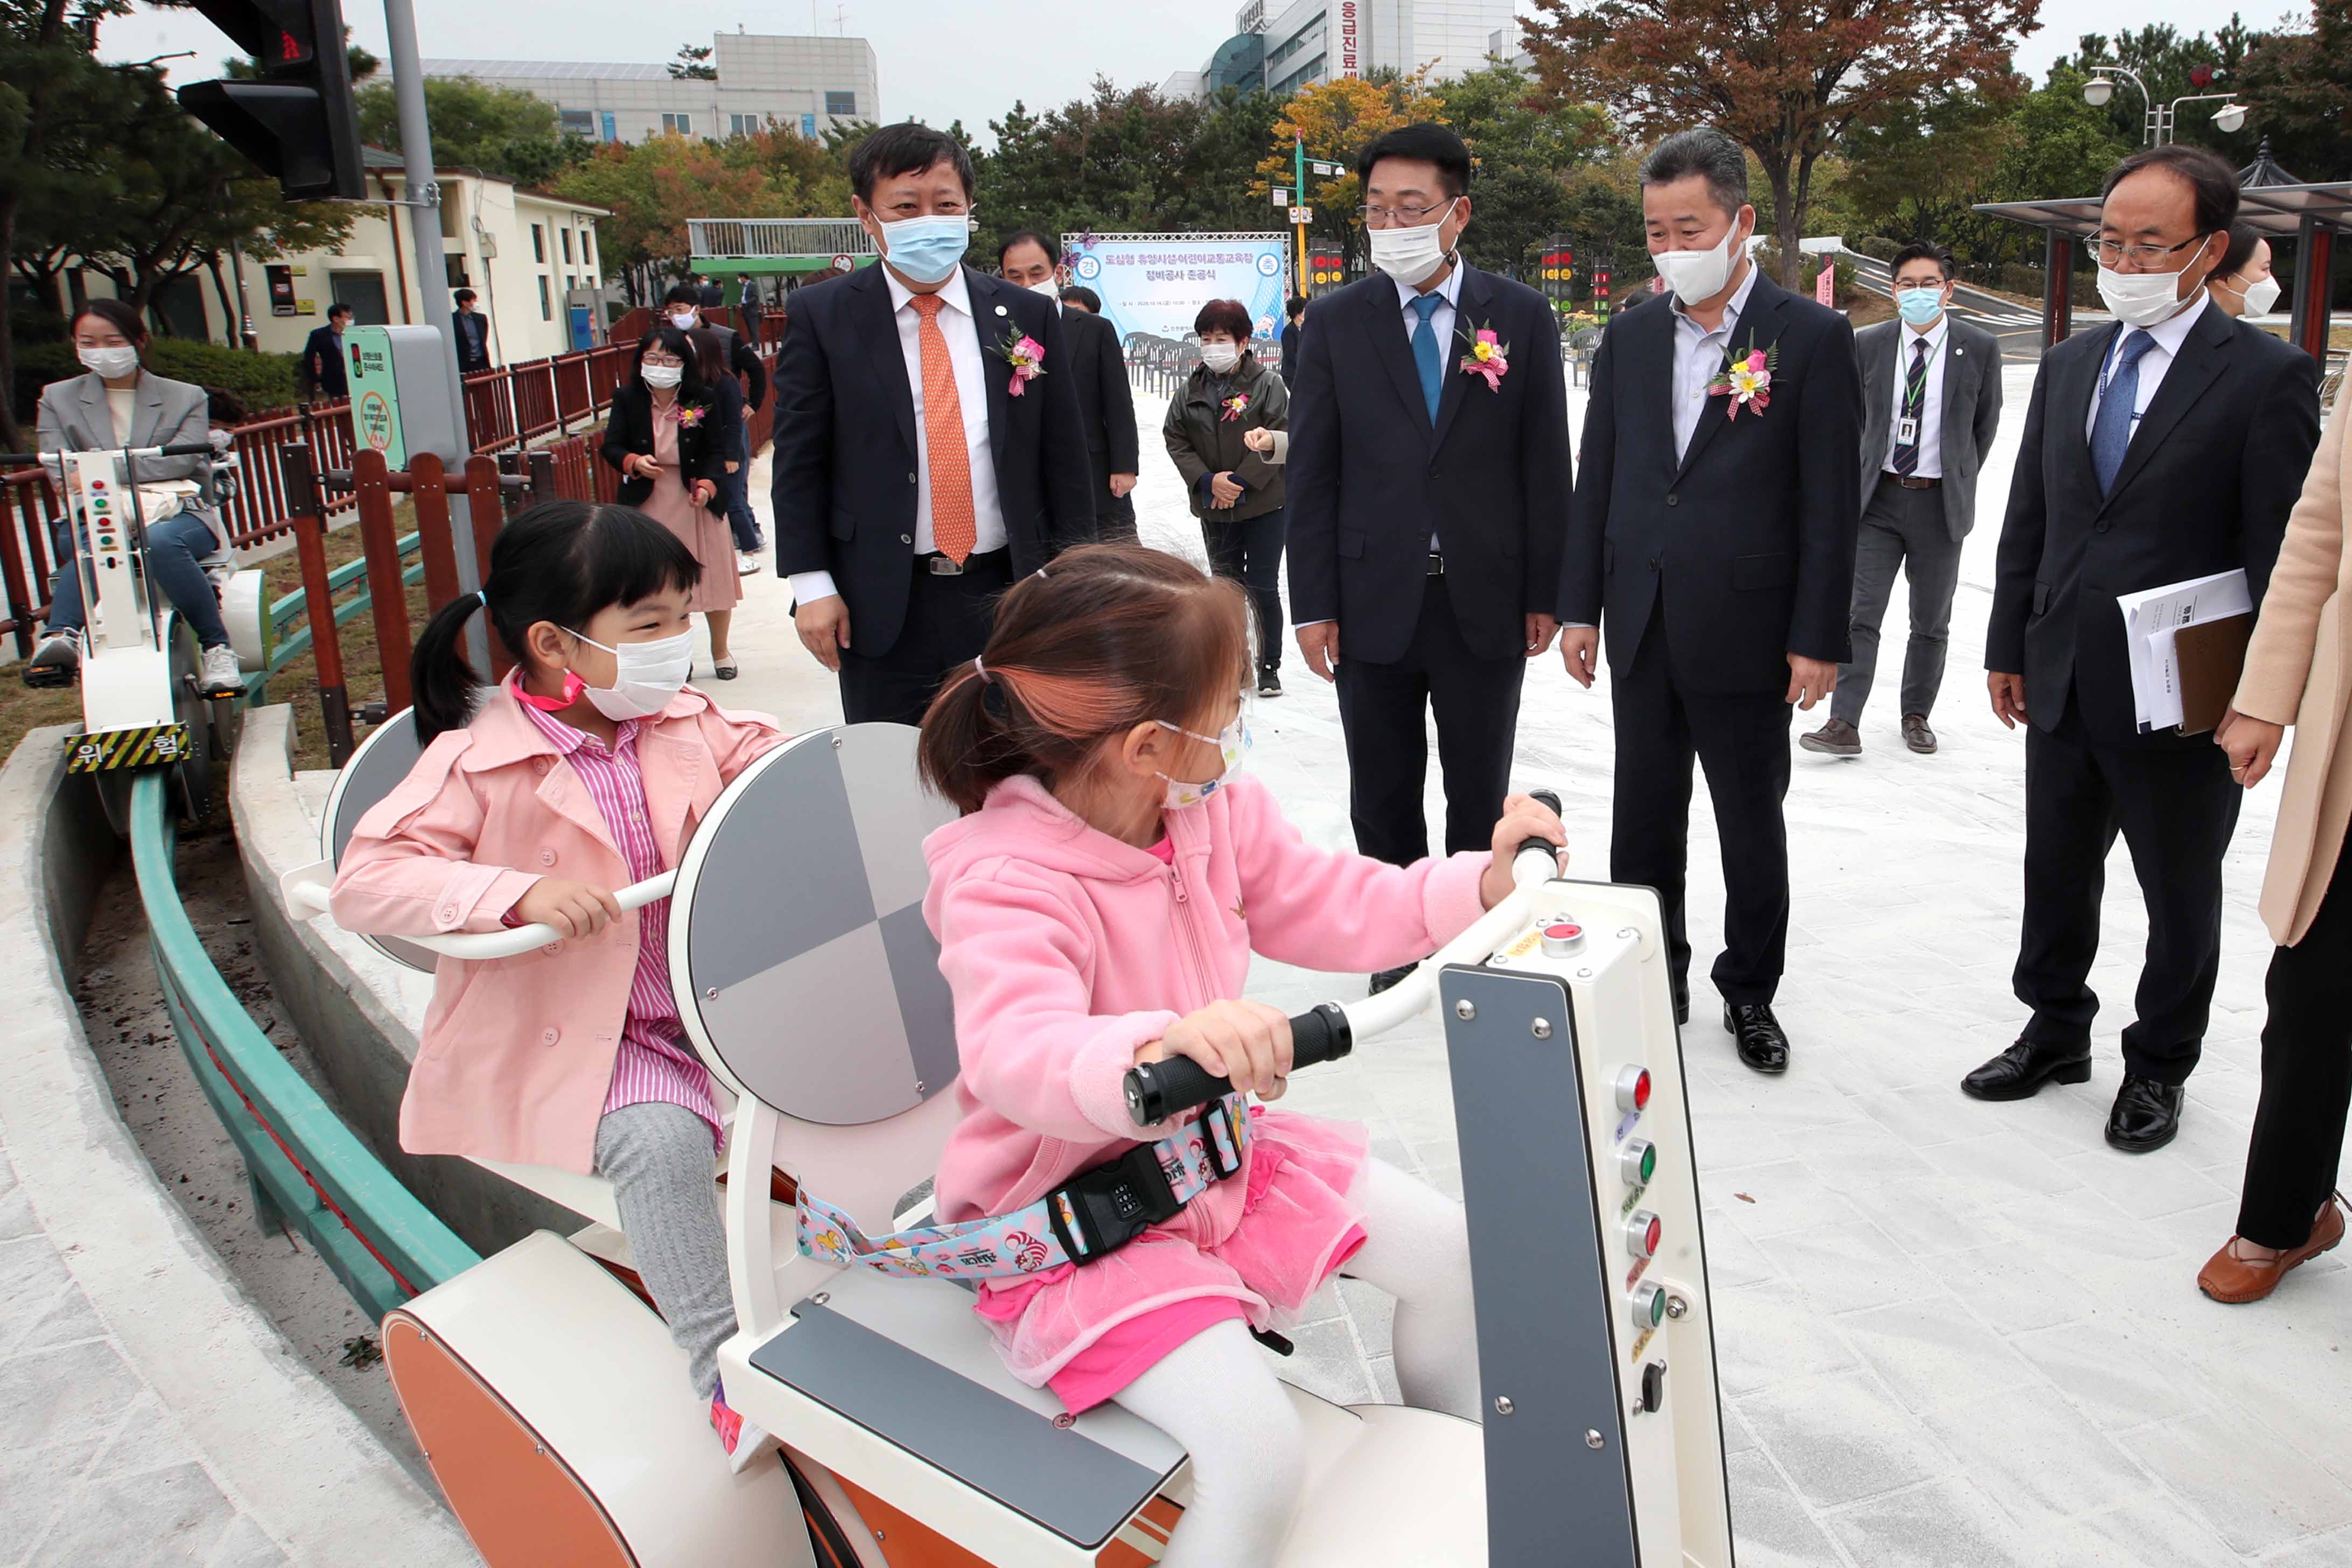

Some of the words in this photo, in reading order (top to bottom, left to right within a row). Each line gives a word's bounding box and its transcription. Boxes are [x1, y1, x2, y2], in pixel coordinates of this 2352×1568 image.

[1105, 254, 1135, 265] 도심형
[1262, 258, 1275, 272] 축
[1082, 261, 1094, 274] 경
[1145, 270, 1185, 282] 정비공사
[1187, 269, 1216, 281] 준공식
